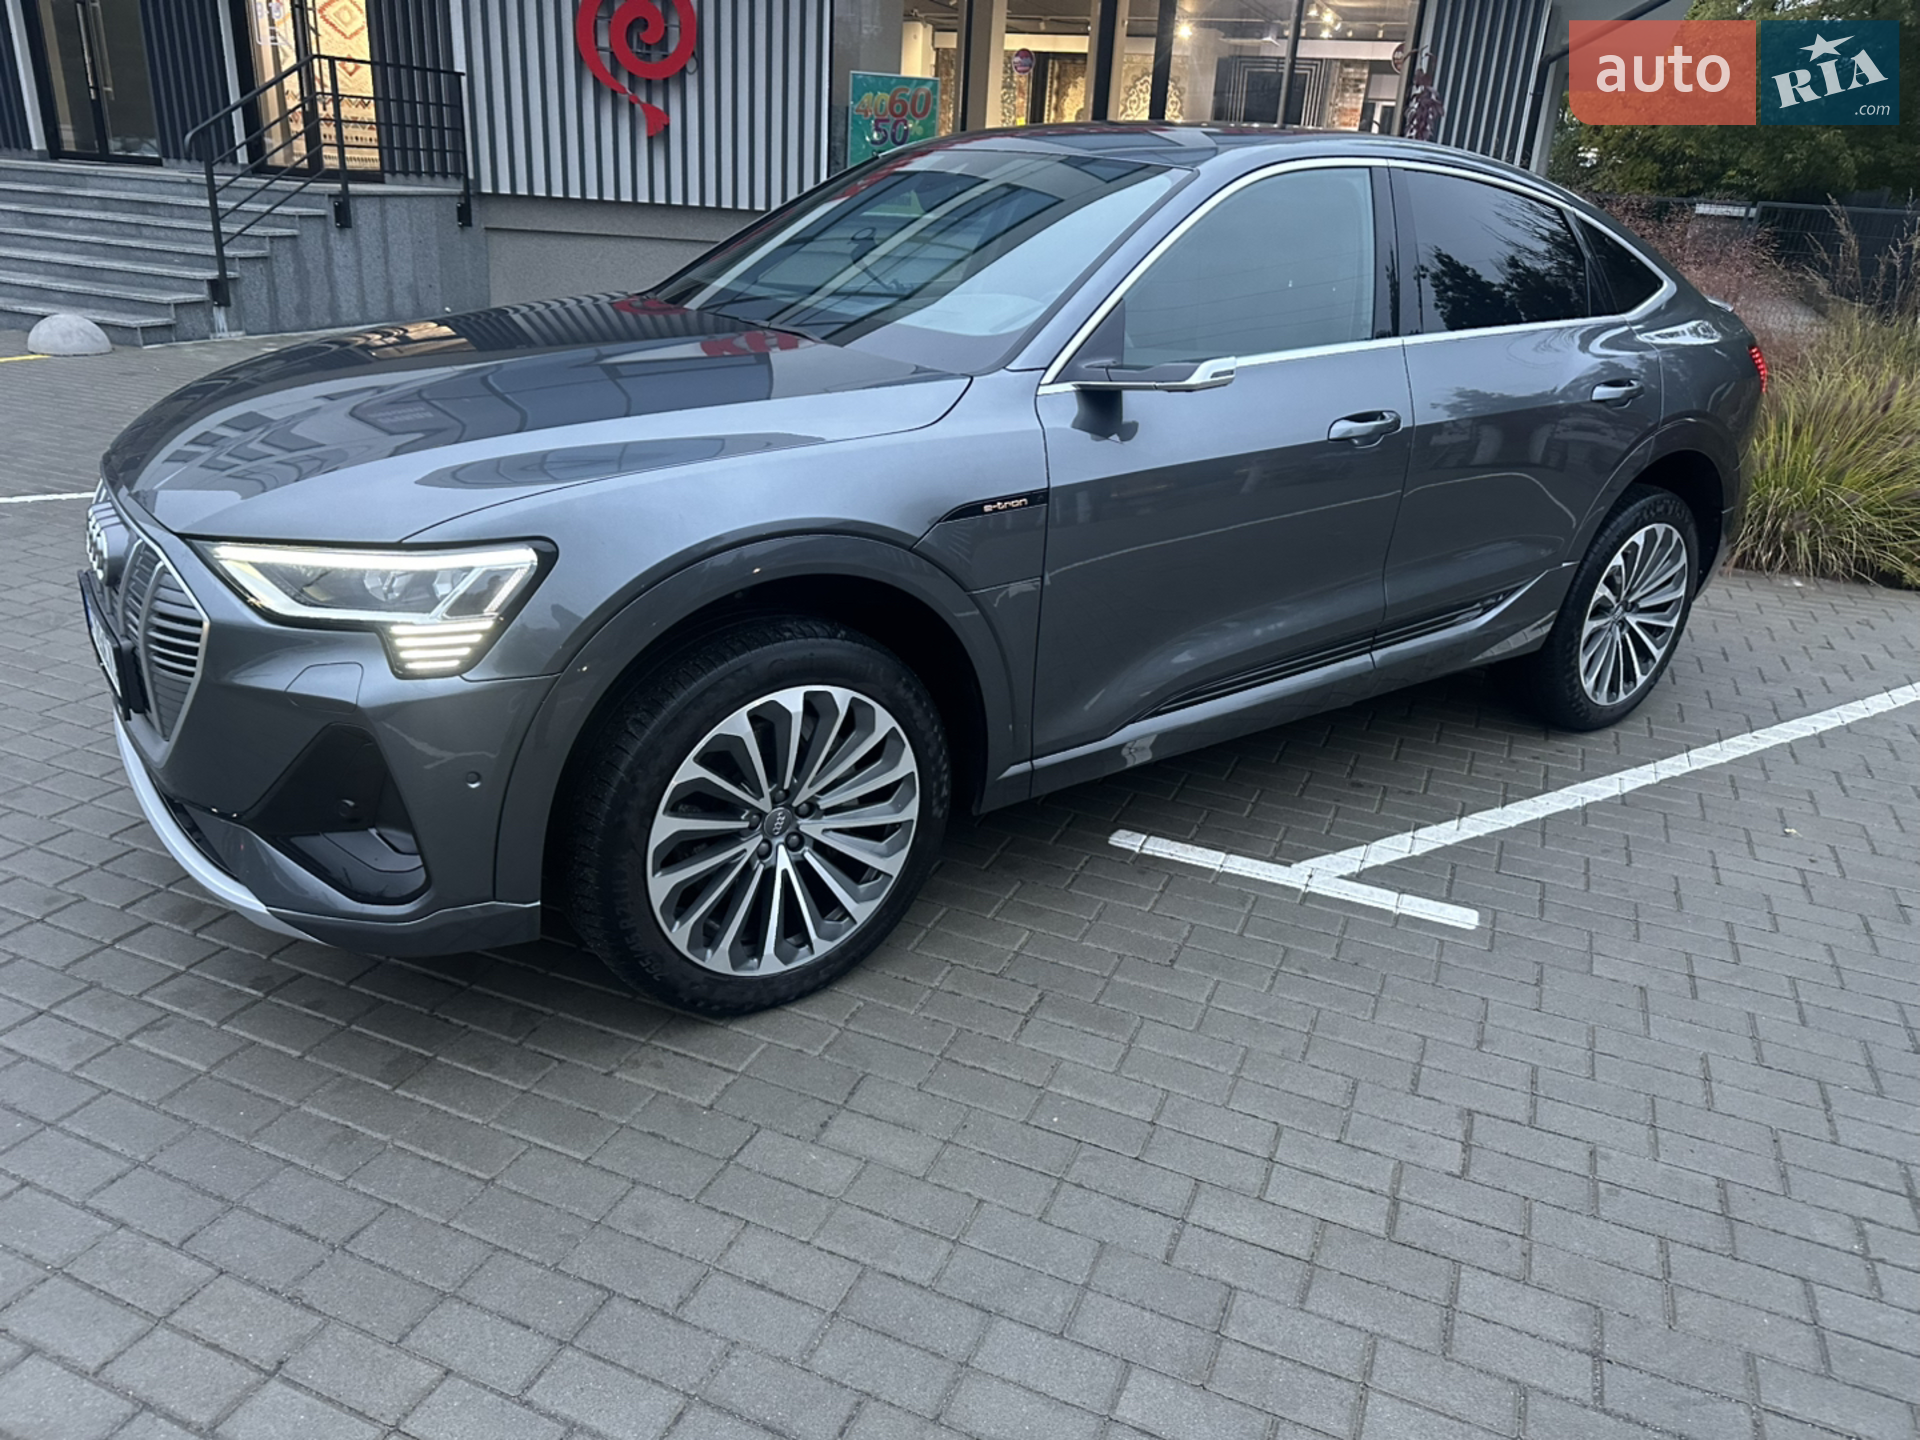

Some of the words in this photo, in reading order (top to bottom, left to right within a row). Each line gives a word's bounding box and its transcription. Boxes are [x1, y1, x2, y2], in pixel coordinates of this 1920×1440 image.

[854, 91, 890, 120] 40
[888, 85, 933, 121] 60
[982, 497, 1028, 513] e-tron
